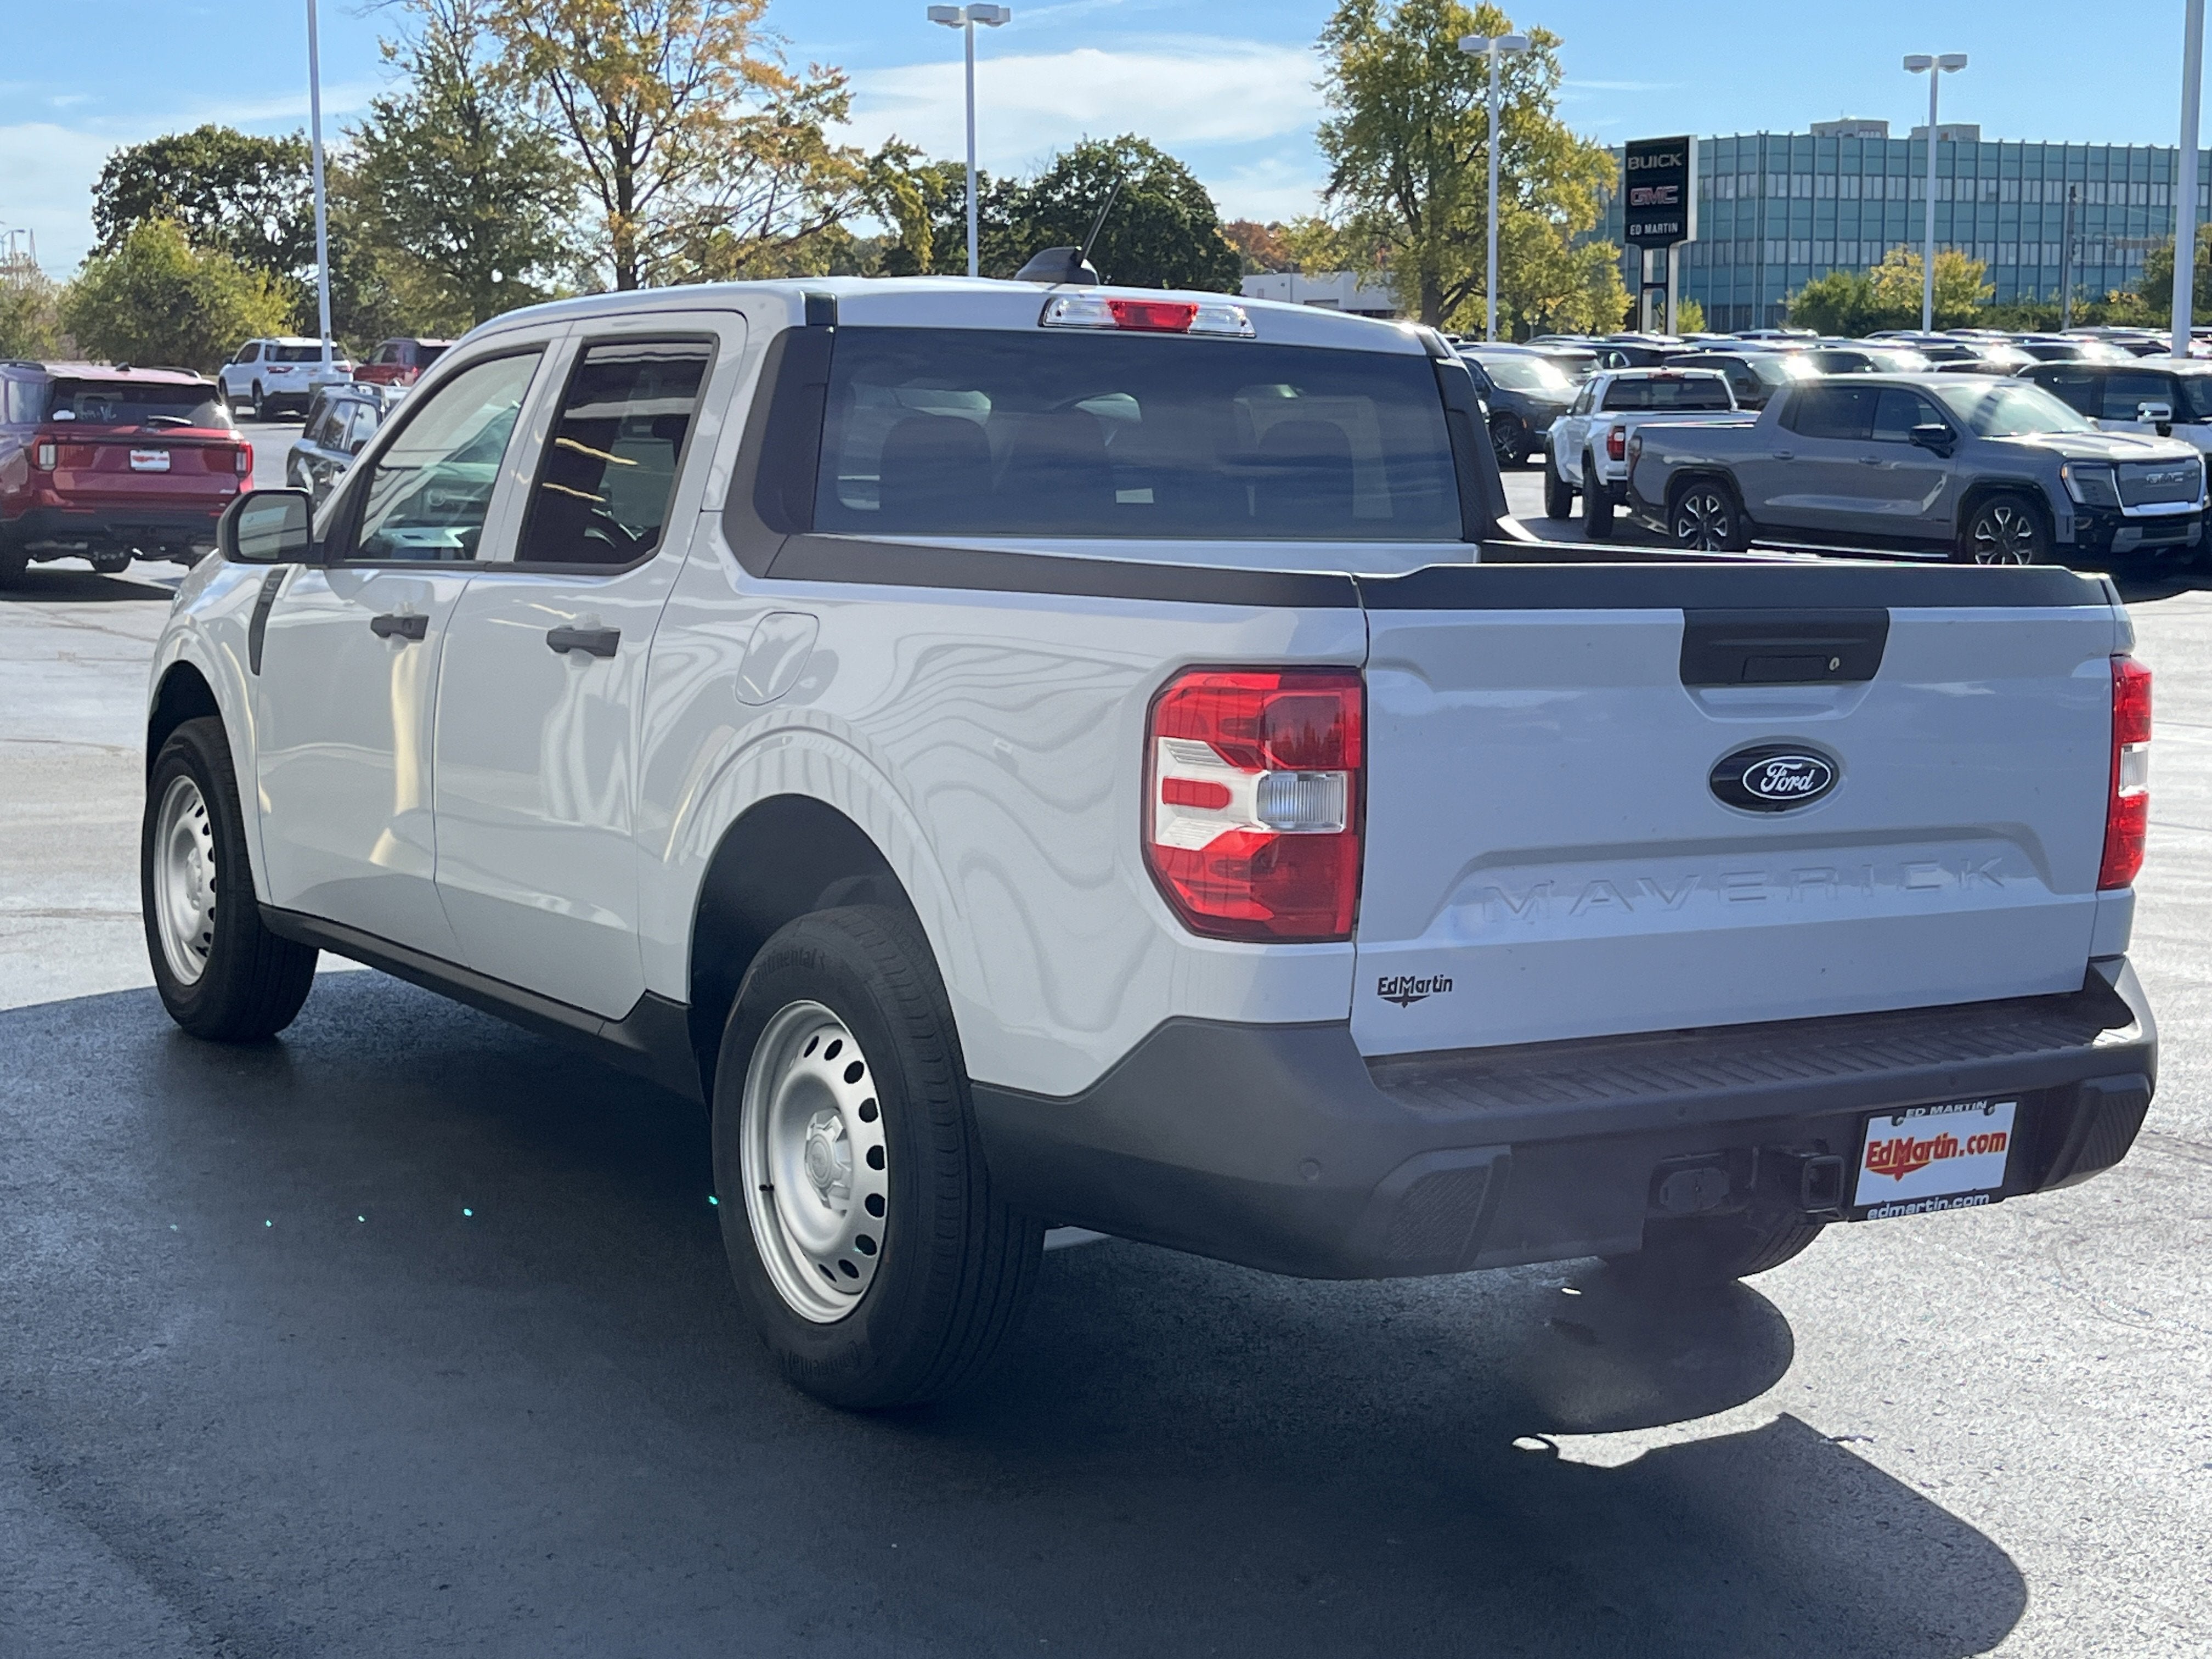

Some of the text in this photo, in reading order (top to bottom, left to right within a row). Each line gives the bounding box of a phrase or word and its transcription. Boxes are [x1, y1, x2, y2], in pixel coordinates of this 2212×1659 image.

[1627, 153, 1683, 170] BUICK
[1630, 185, 1678, 206] GMC
[1630, 223, 1678, 235] ED MARTIN
[1760, 763, 1815, 792] Ford
[1482, 857, 2005, 924] MAVERICK
[1377, 974, 1453, 999] EdMartin
[1905, 1101, 1988, 1118] ED MARTIN
[1865, 1131, 2007, 1170] EdMartin.com
[1867, 1193, 1990, 1221] edmartin.com
